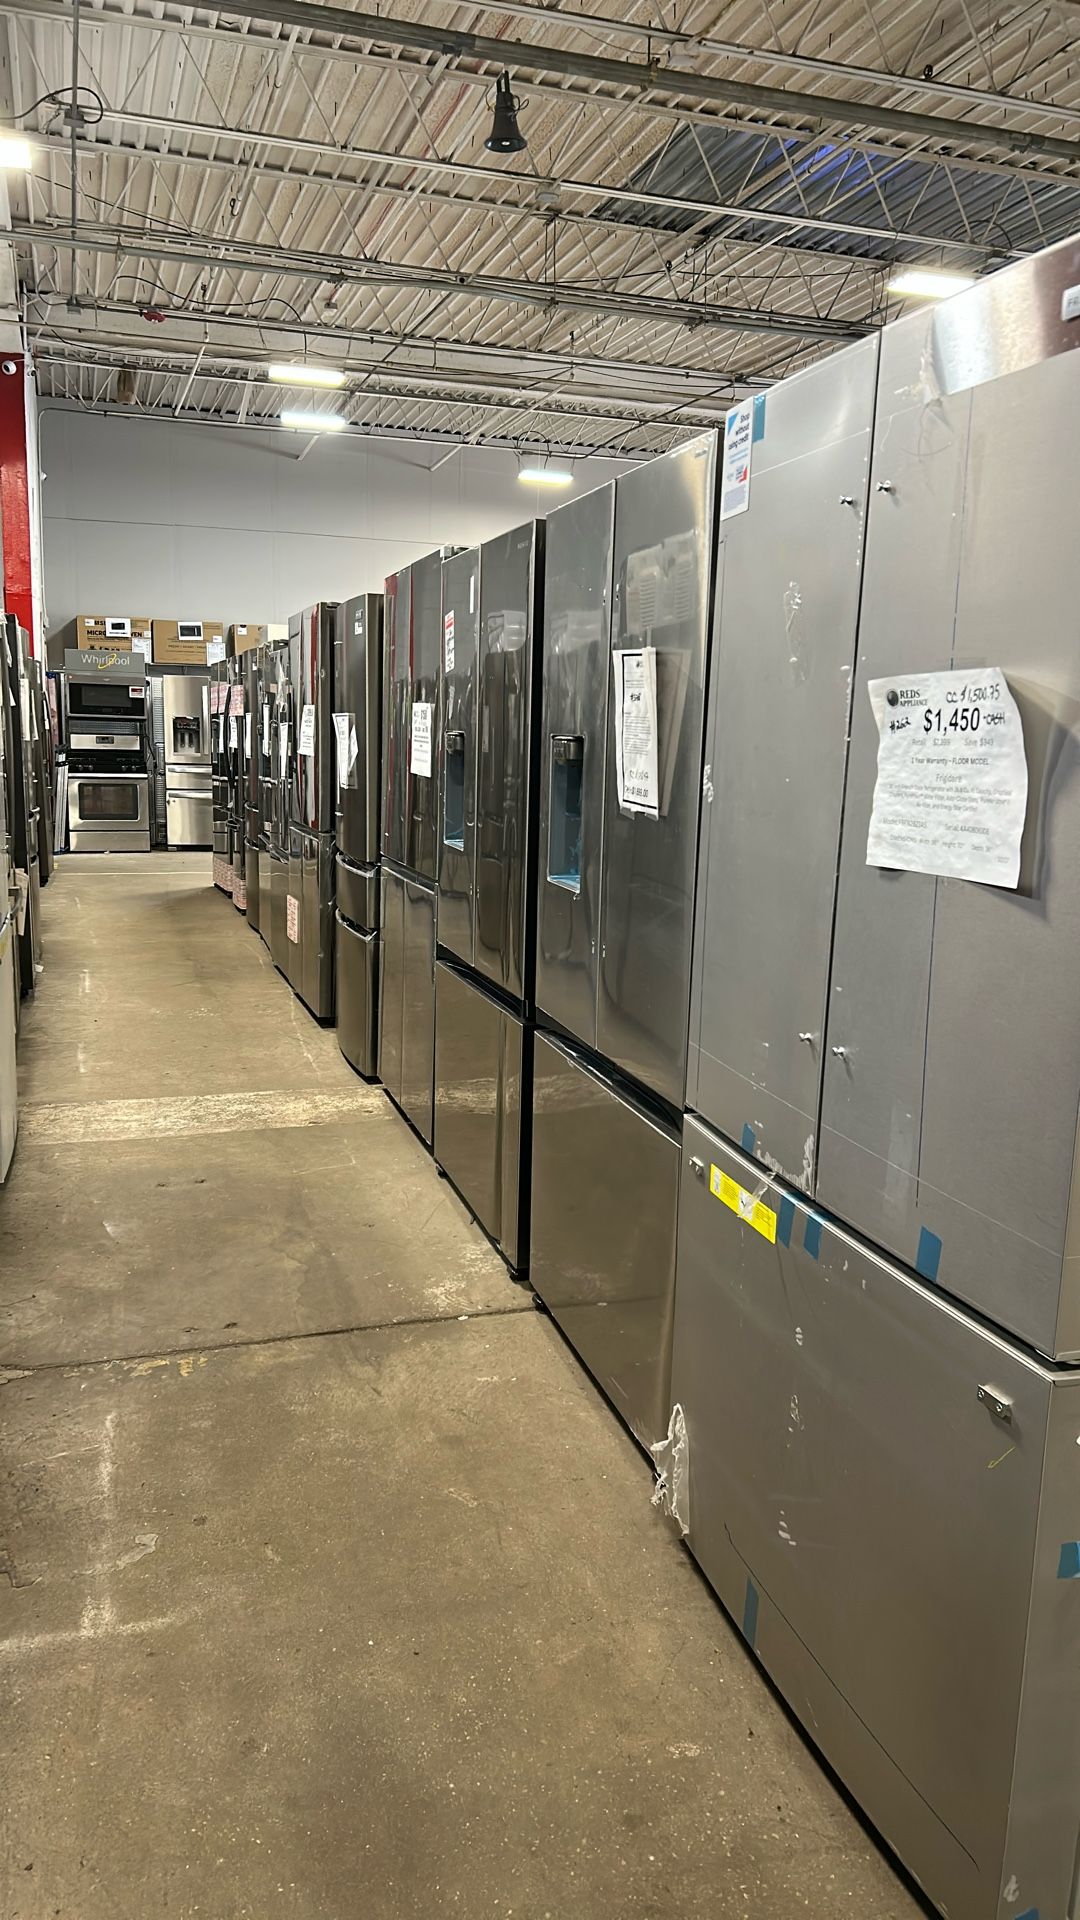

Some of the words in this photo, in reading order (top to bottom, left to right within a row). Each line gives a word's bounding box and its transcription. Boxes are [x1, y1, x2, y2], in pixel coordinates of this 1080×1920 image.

[81, 654, 130, 668] Whirlpool
[899, 689, 921, 699] REDS
[899, 699, 928, 707] APPLIANCE
[923, 707, 980, 736] $1,450
[926, 757, 948, 766] Warranty
[952, 757, 969, 765] FLOOR
[970, 758, 990, 766] MODEL
